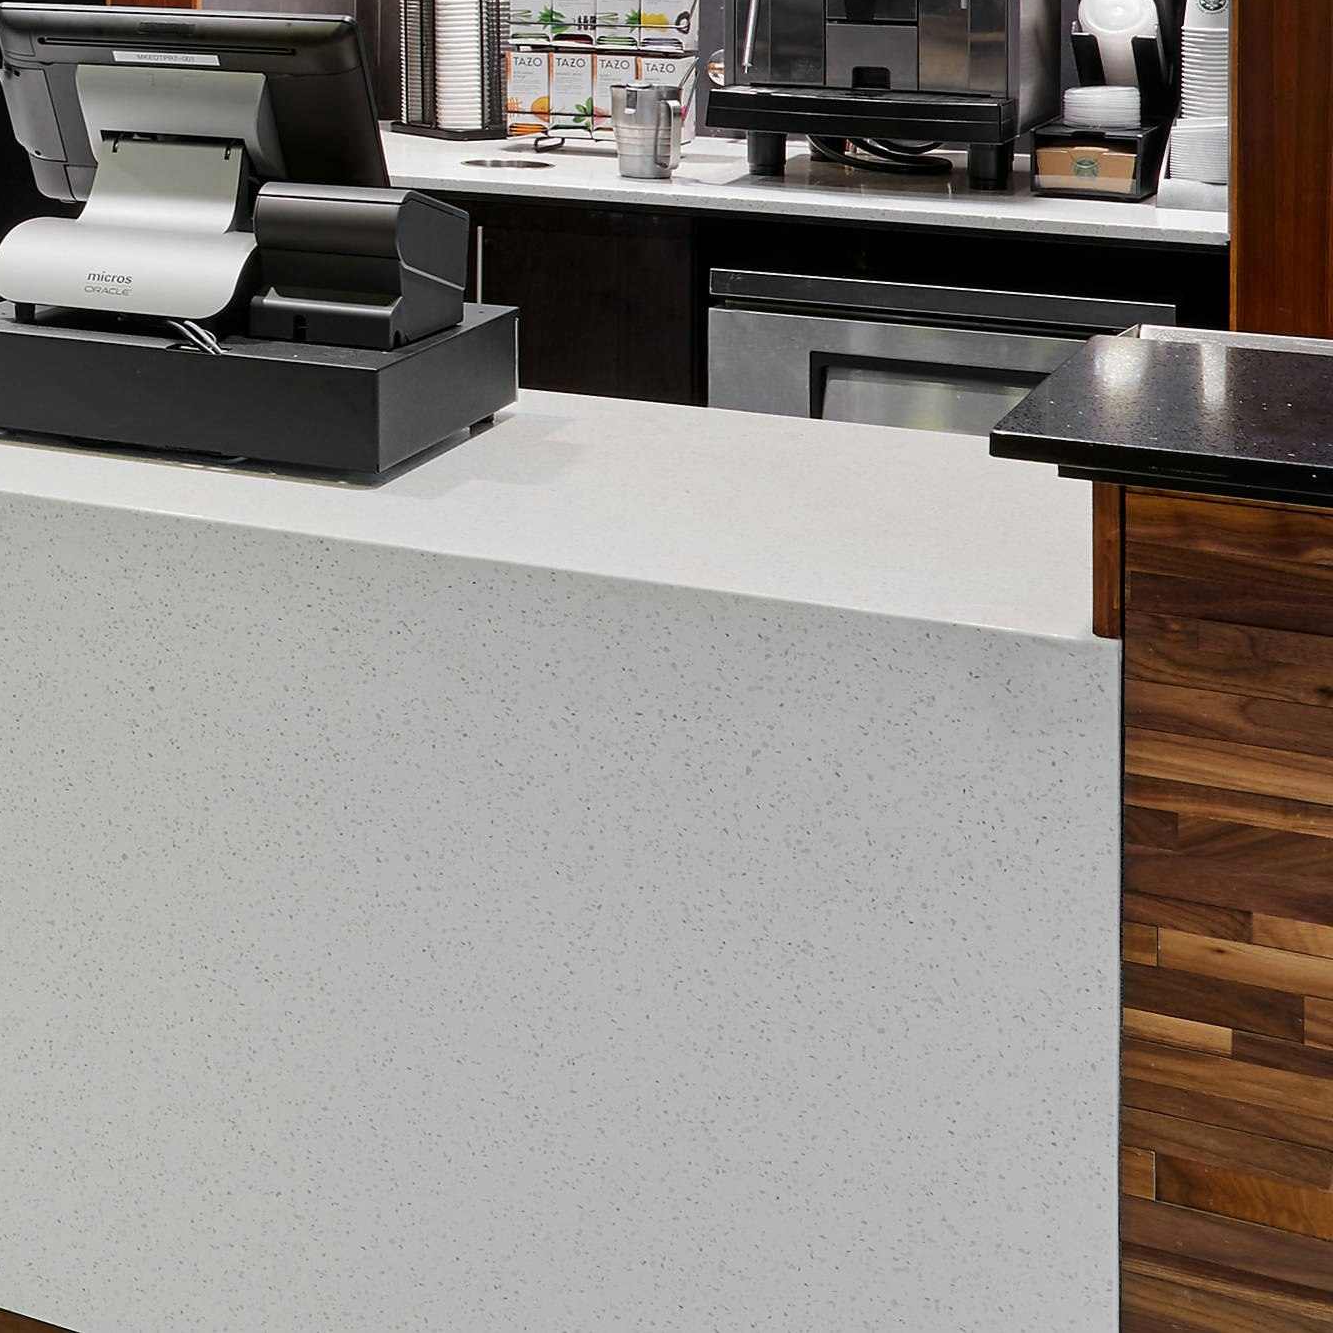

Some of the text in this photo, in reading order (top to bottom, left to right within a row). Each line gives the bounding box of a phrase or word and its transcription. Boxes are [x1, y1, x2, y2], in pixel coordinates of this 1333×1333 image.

[513, 56, 543, 68] TAZO
[556, 57, 586, 69] TAZO
[599, 59, 630, 70] TAZO
[645, 62, 675, 74] TAZO
[87, 271, 133, 285] micros
[84, 285, 133, 297] ORACLE
